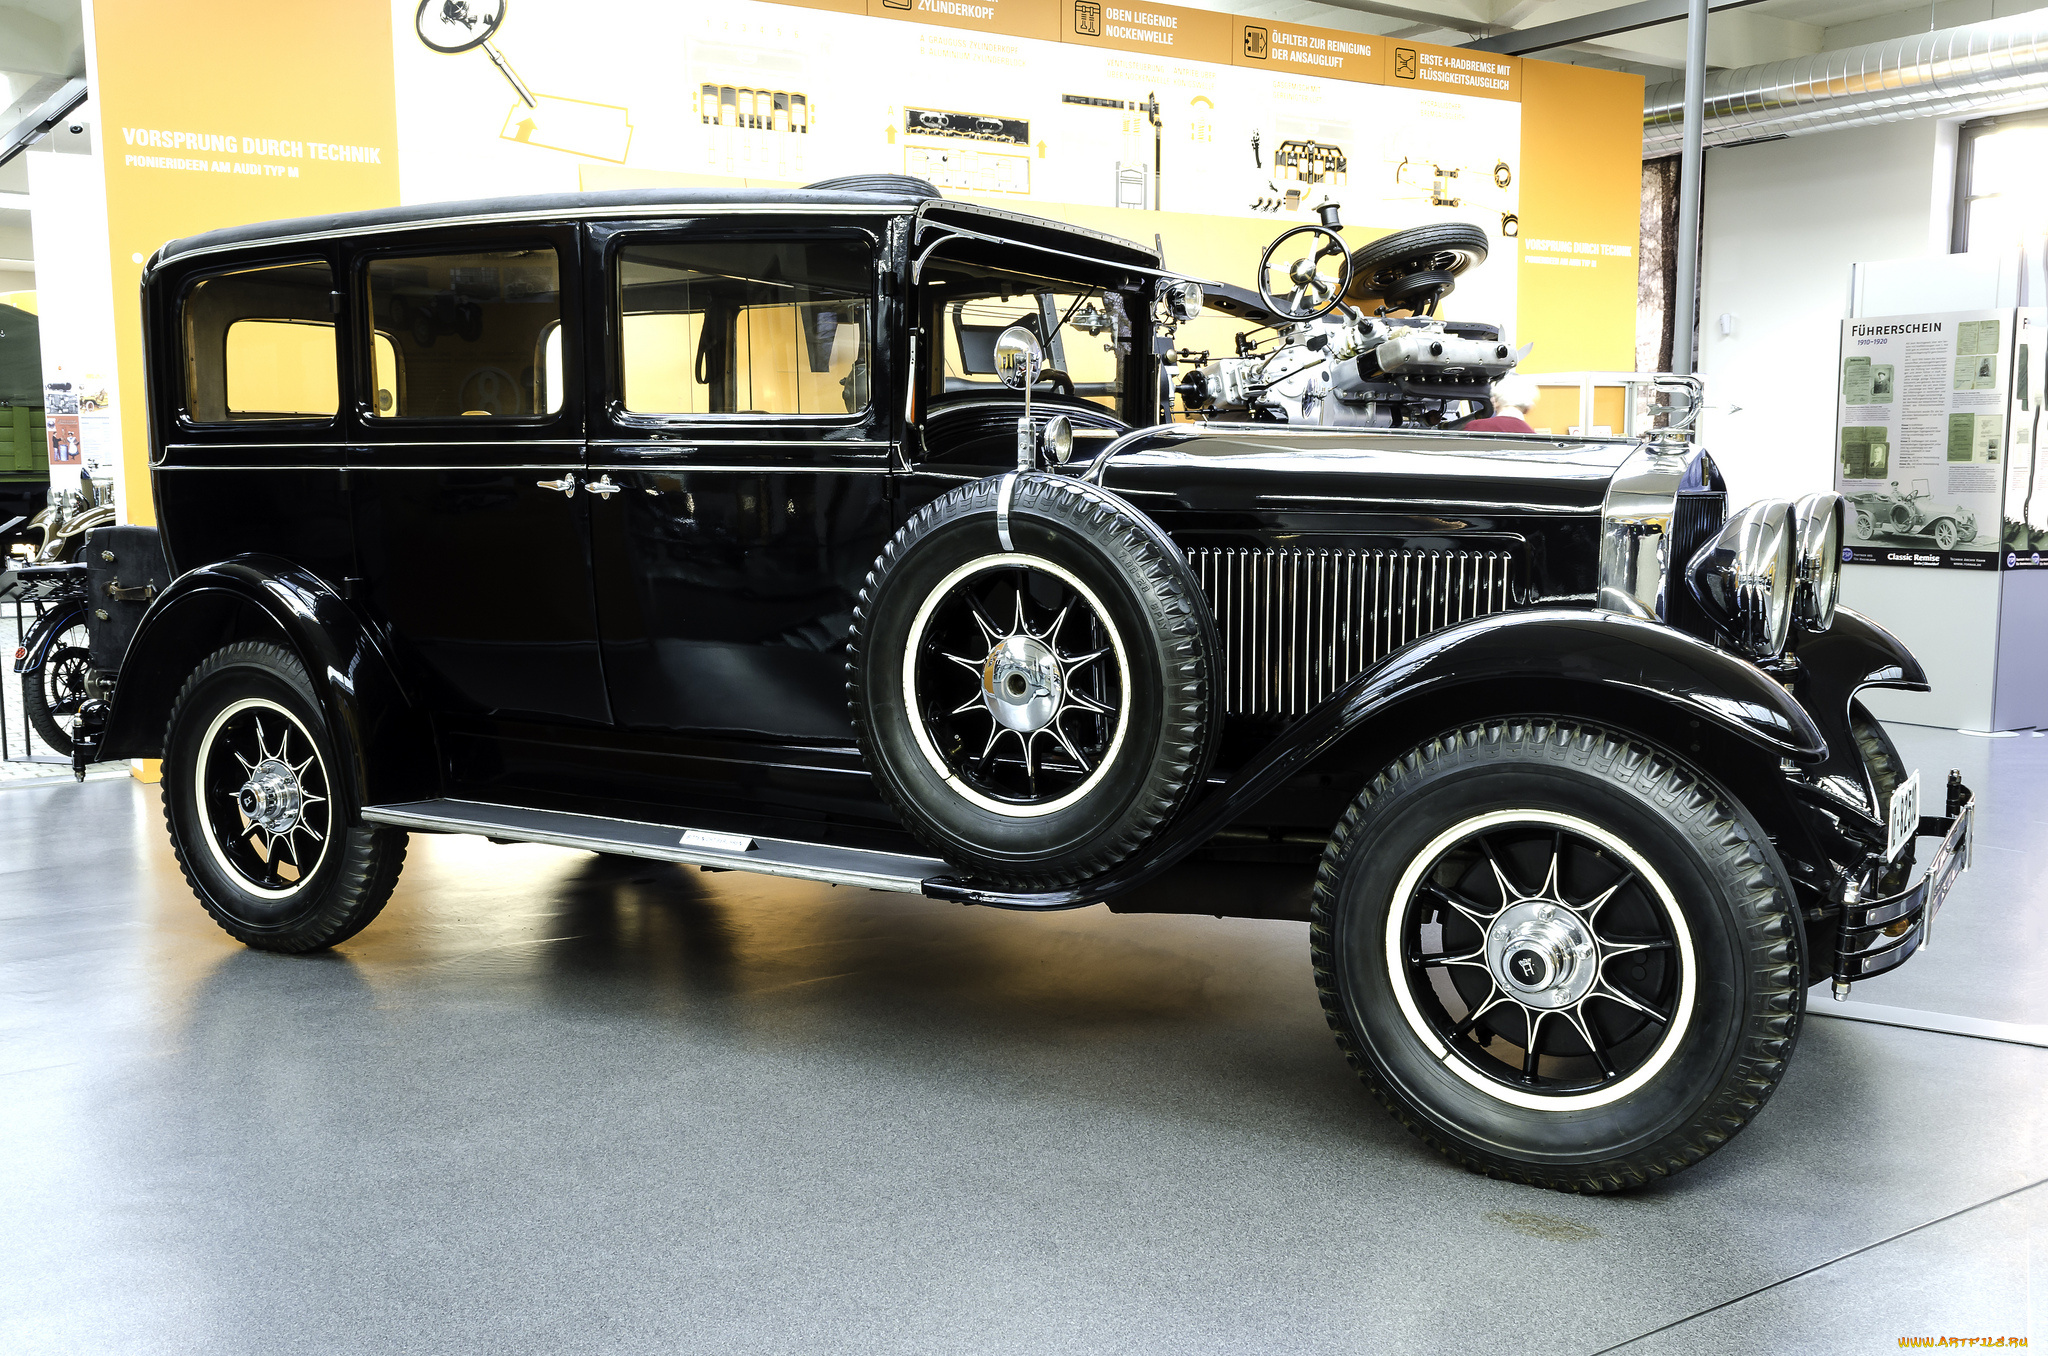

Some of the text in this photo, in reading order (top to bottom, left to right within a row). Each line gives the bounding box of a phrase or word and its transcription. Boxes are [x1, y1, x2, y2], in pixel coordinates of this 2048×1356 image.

[918, 0, 994, 19] ZYLINDERKOPF
[1106, 7, 1178, 29] OBEN LIEGENDE
[1106, 24, 1174, 45] NOCKENWELLE
[1272, 29, 1371, 57] ÖLFILTER ZUR REINIGUNG
[1272, 48, 1343, 69] DER ANSAUGLUFT
[1420, 53, 1511, 76] ERSTE 4-RADBREMSE MIT
[1420, 69, 1510, 91] FLÜSSIGKEITSAUSGLEICH
[122, 127, 381, 164] VORSPRUNG DURCH TECHNIK
[125, 154, 299, 178] PIONIERIDEEN AM AUDI TYP M
[1525, 238, 1632, 257] VORSPRUNG DURCH TECHNIK
[1852, 322, 1942, 337] FÜHRERSCHEIN
[1913, 554, 1940, 562] Remise
